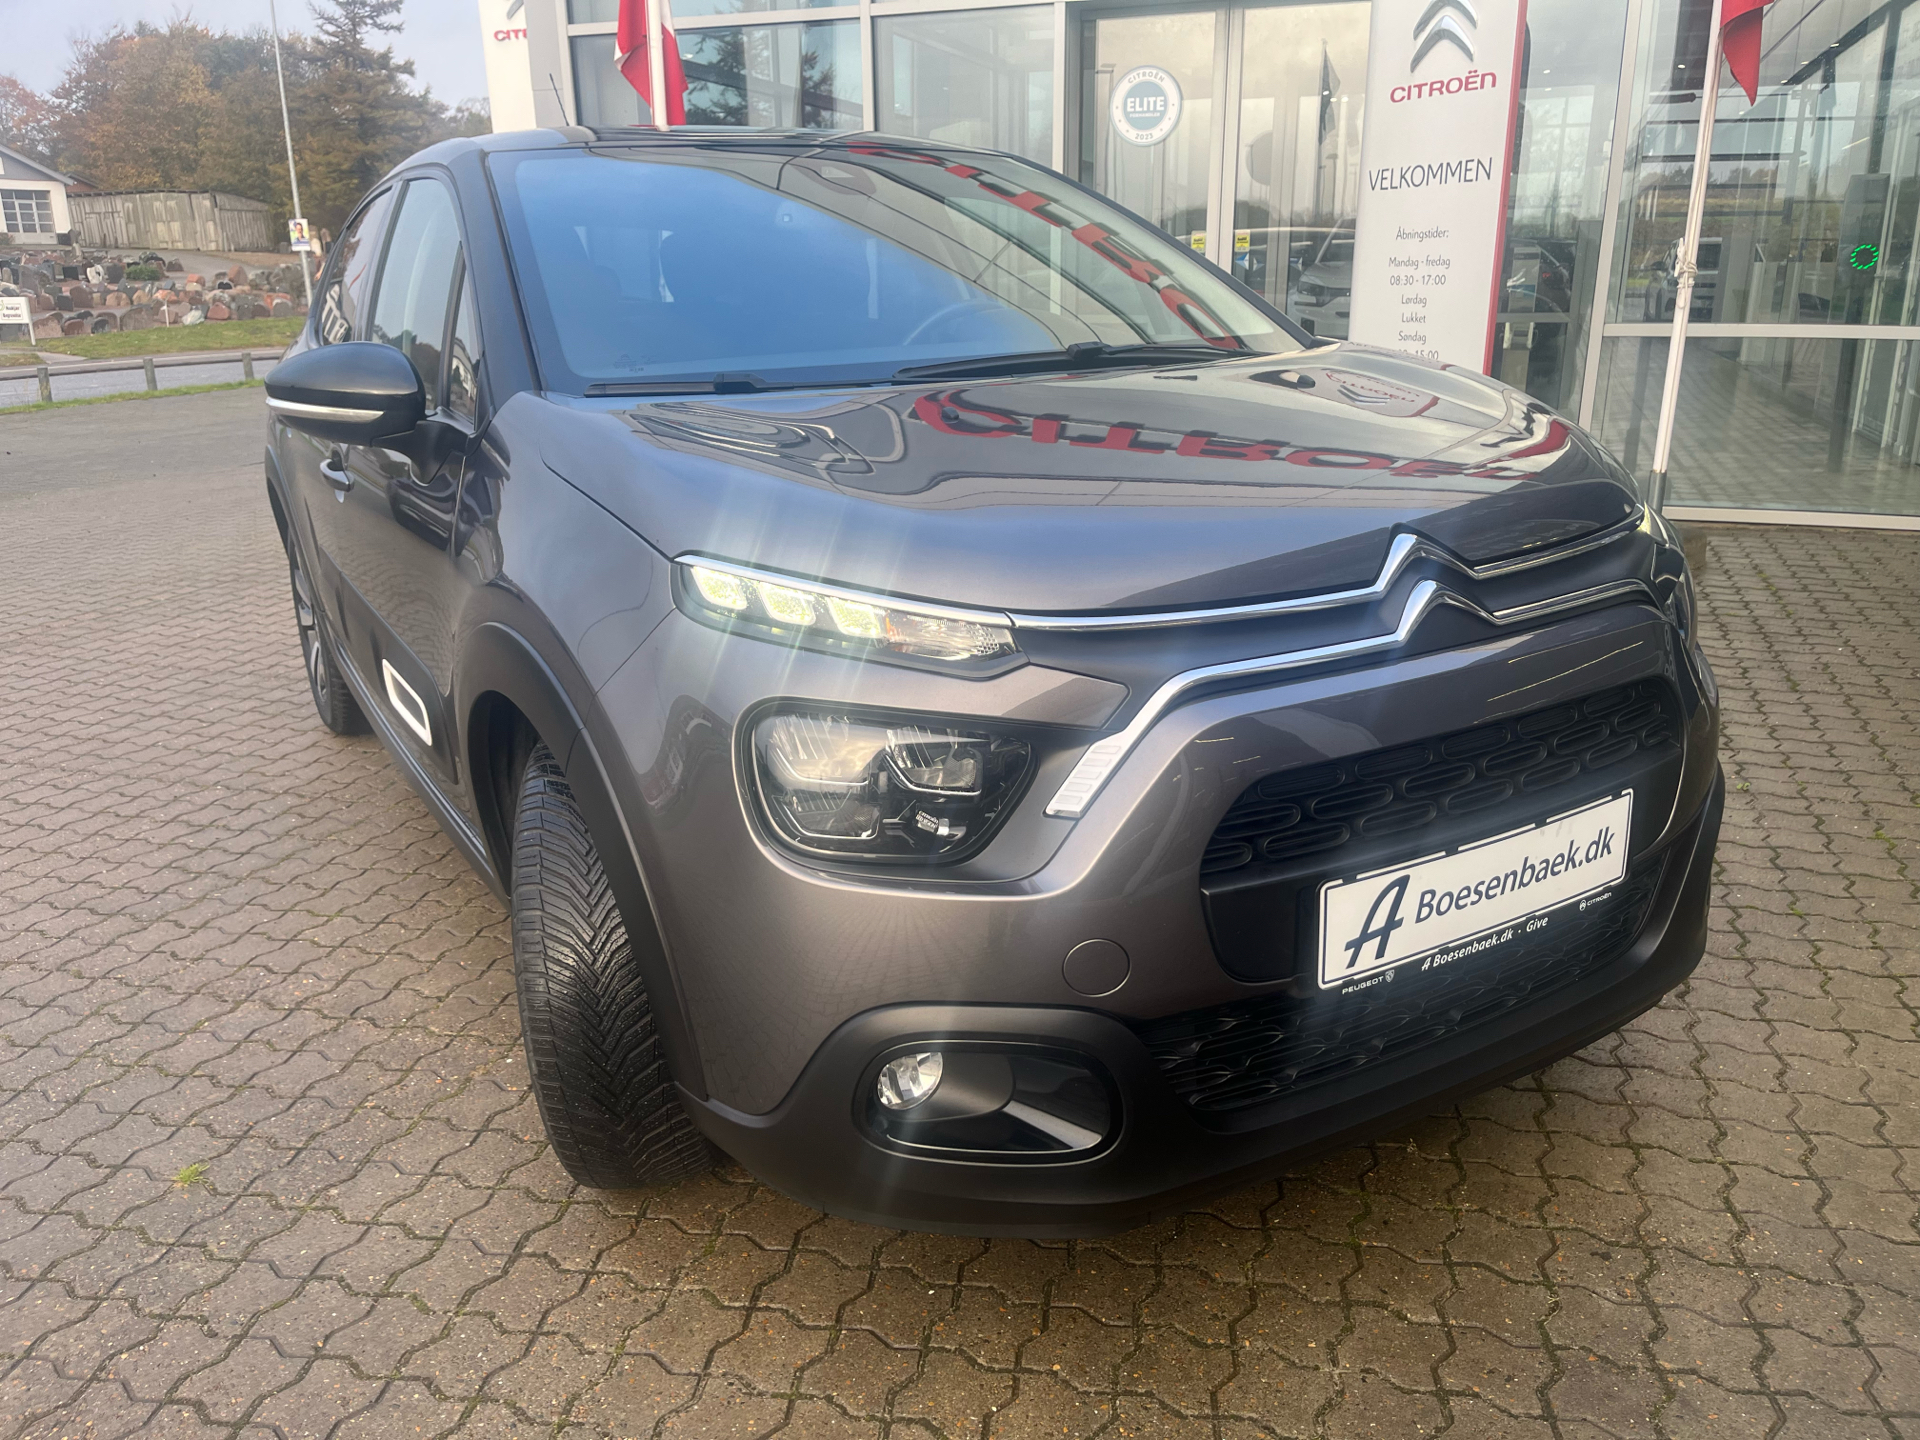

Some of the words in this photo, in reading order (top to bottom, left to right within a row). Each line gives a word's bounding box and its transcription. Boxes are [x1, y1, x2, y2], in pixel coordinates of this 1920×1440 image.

[1127, 71, 1165, 84] CITROËN
[1390, 69, 1497, 103] CITROËN
[1126, 96, 1165, 112] ELITE
[1135, 132, 1153, 140] 2023
[1368, 156, 1493, 191] VELKOMMEN
[1395, 226, 1449, 242] Åbningstider:
[1388, 255, 1419, 270] Mandag
[1425, 254, 1451, 270] fredag
[1389, 275, 1414, 286] 08:30
[1421, 274, 1447, 286] 17:00
[1401, 293, 1428, 308] Lørdag
[1401, 311, 1426, 323] Lukket
[1398, 330, 1427, 345] Søndag
[1344, 874, 1411, 969] A
[1415, 826, 1615, 923] Boesenbaek.dk
[1432, 928, 1514, 968] Boesenbaek.dk
[1526, 917, 1549, 932] Give
[1341, 975, 1384, 995] PEUGEOT
